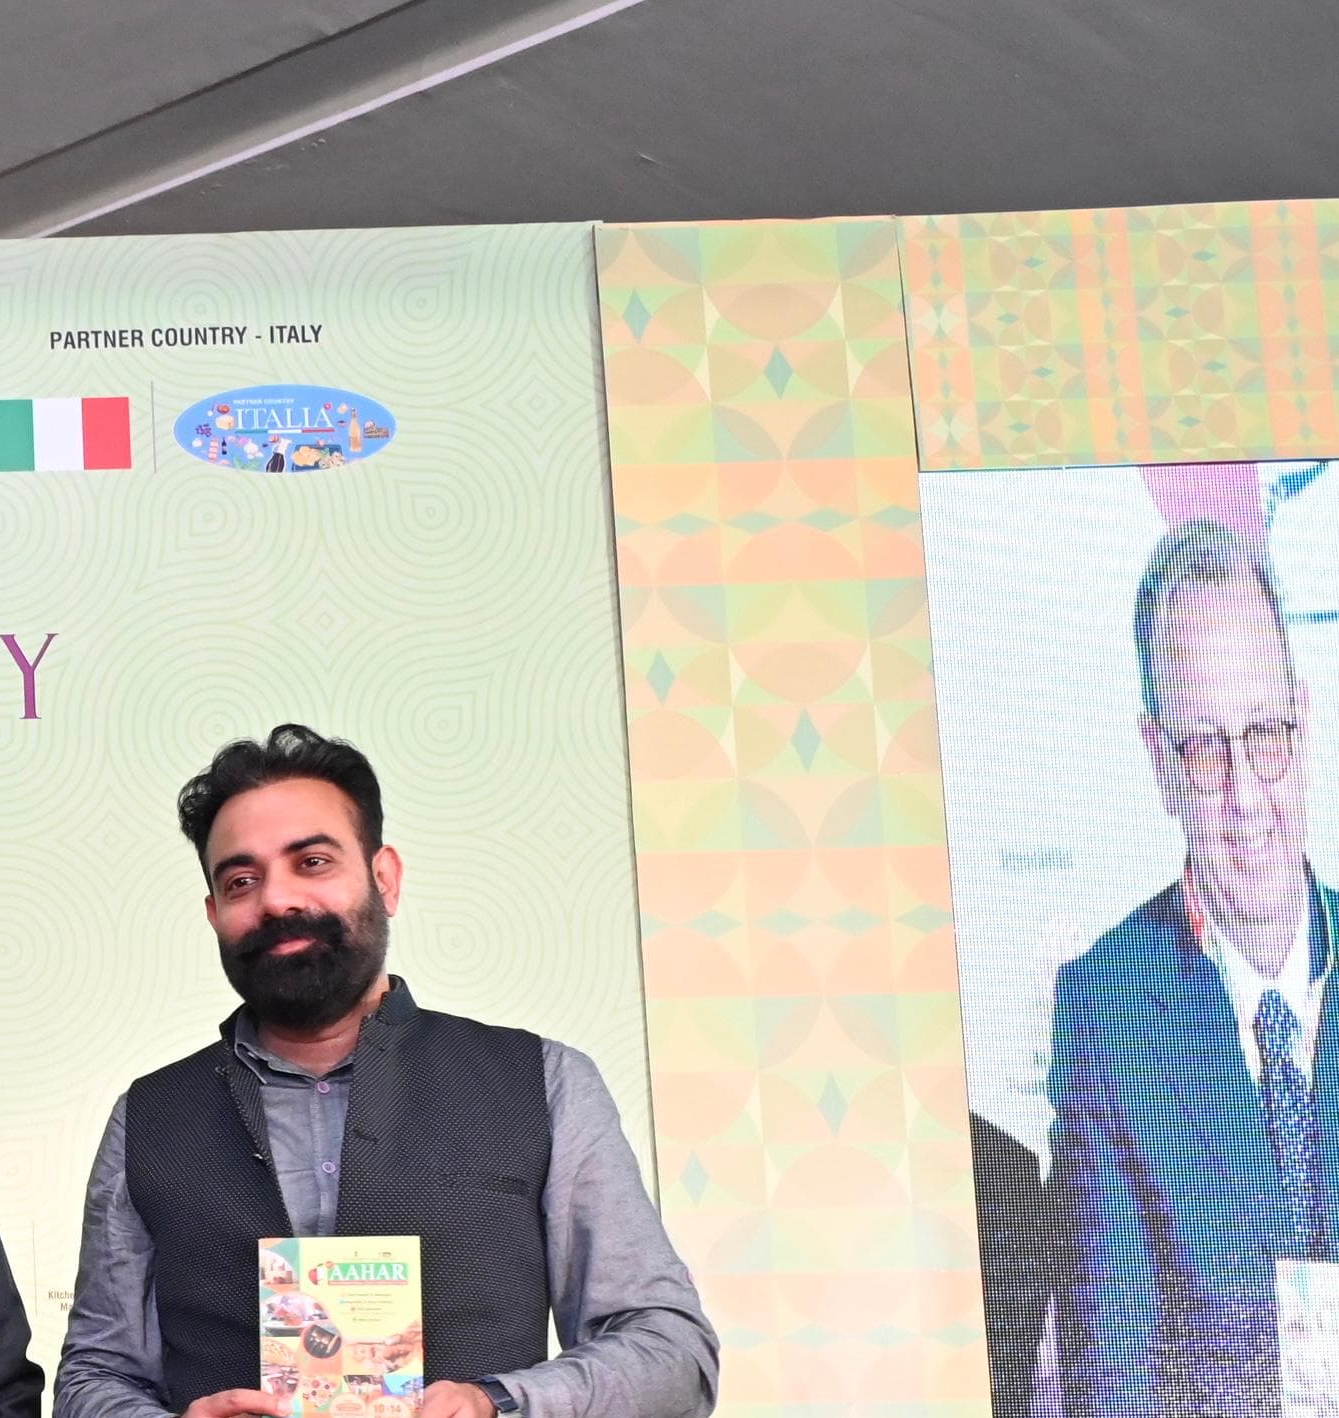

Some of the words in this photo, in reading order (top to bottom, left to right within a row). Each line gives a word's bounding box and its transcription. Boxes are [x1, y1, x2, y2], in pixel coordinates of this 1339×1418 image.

[50, 330, 144, 350] PARTNER
[151, 327, 247, 347] COUNTRY
[269, 324, 322, 344] ITALY
[236, 407, 334, 429] ITALIA
[329, 1263, 408, 1281] AAHAR
